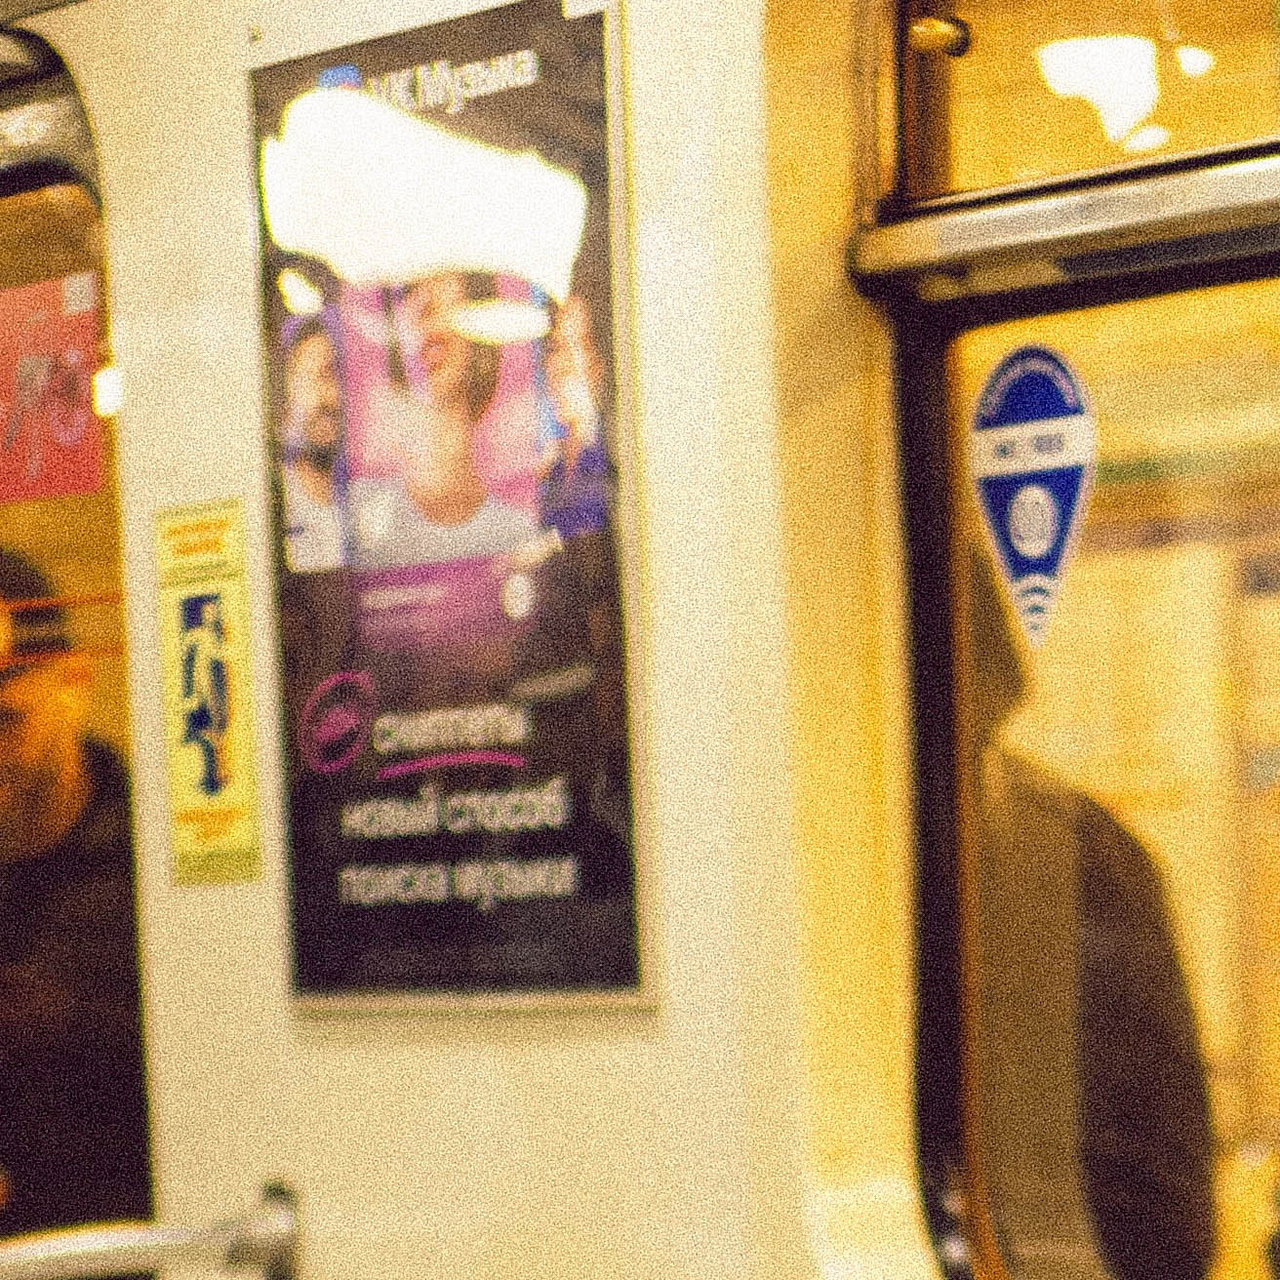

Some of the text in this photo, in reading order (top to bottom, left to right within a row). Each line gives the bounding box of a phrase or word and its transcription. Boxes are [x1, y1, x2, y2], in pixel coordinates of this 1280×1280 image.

[415, 48, 540, 116] Музыка
[341, 775, 568, 838] новый способ
[339, 856, 578, 912] поиска музыки
